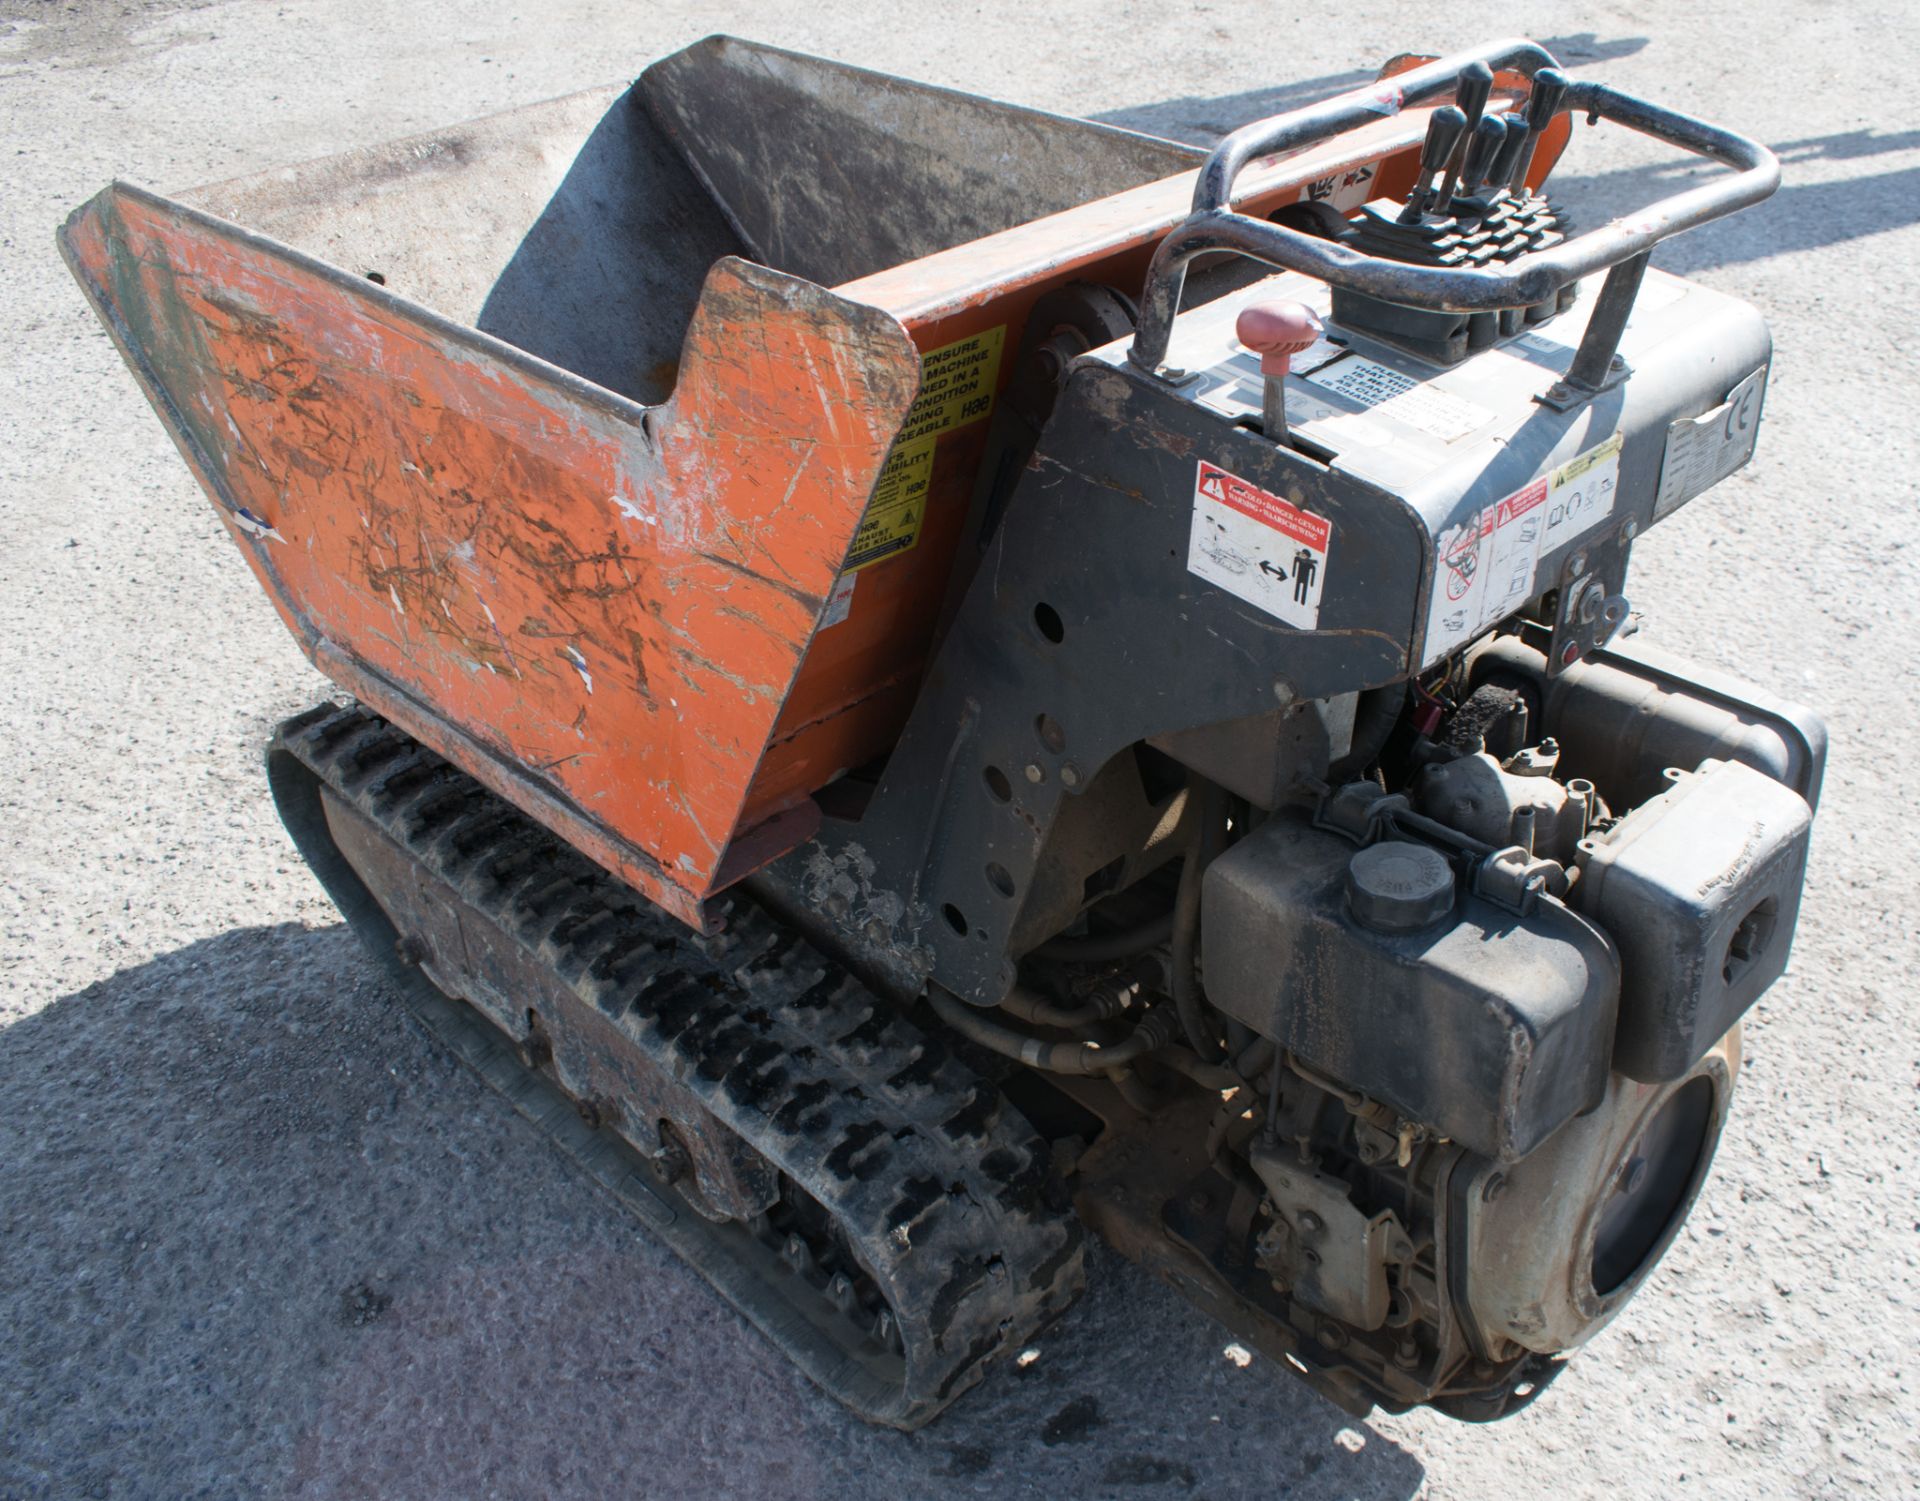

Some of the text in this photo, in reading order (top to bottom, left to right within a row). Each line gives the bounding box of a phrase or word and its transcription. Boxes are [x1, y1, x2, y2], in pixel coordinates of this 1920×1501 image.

[923, 340, 980, 368] ENSURE
[926, 349, 990, 381] MACHINE
[953, 371, 967, 383] IN
[970, 367, 980, 377] A
[1320, 379, 1333, 387] IS
[1336, 379, 1352, 388] AS
[1343, 374, 1384, 394] CLEAN
[1355, 365, 1385, 379] THAT
[913, 380, 978, 412] ONDITION
[1228, 492, 1318, 541] WARNING WAARSCHUWING
[1266, 502, 1294, 521] DANGER
[1297, 517, 1325, 536] GEVAAR
